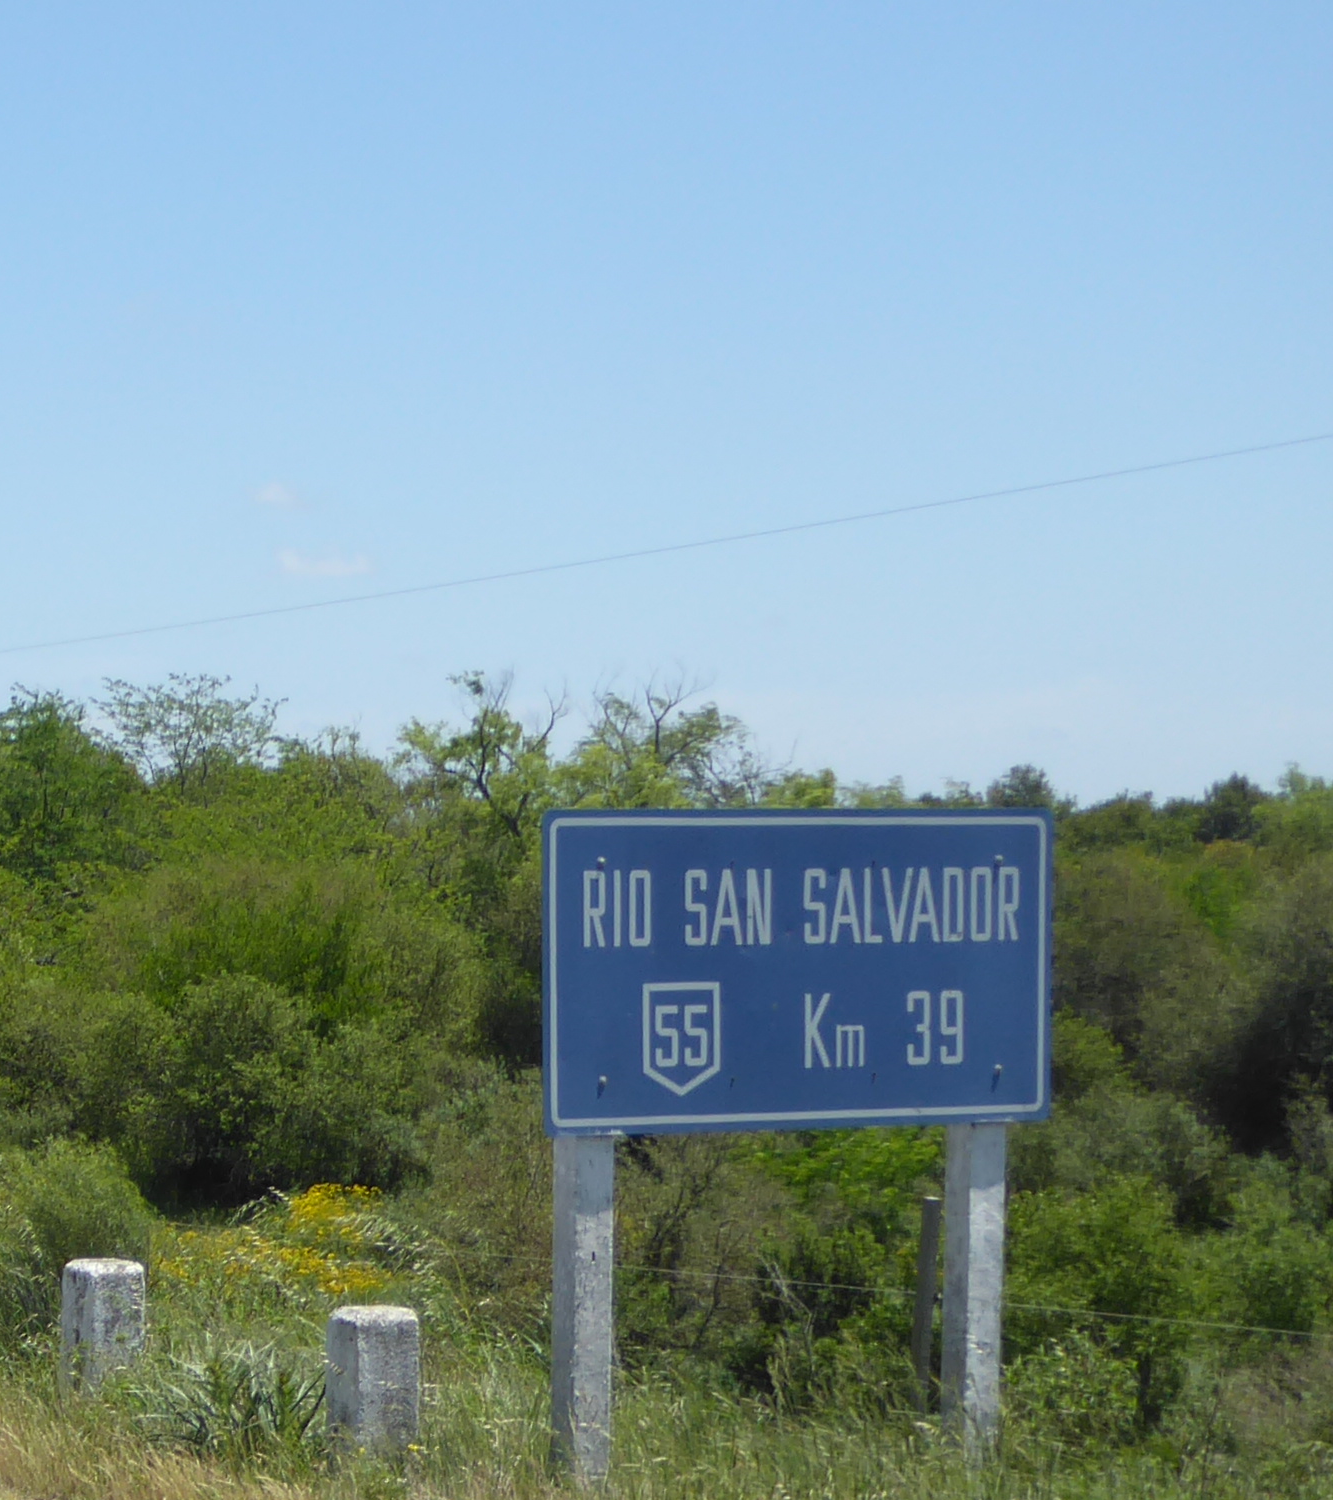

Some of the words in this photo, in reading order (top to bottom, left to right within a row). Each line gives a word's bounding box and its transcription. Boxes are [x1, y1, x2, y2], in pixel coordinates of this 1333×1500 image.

[583, 869, 651, 947] RIO
[685, 868, 771, 946] SAN
[803, 866, 1019, 944] SALVADOR
[655, 1004, 708, 1067] 55
[804, 993, 865, 1068] Km
[907, 990, 964, 1065] 39
